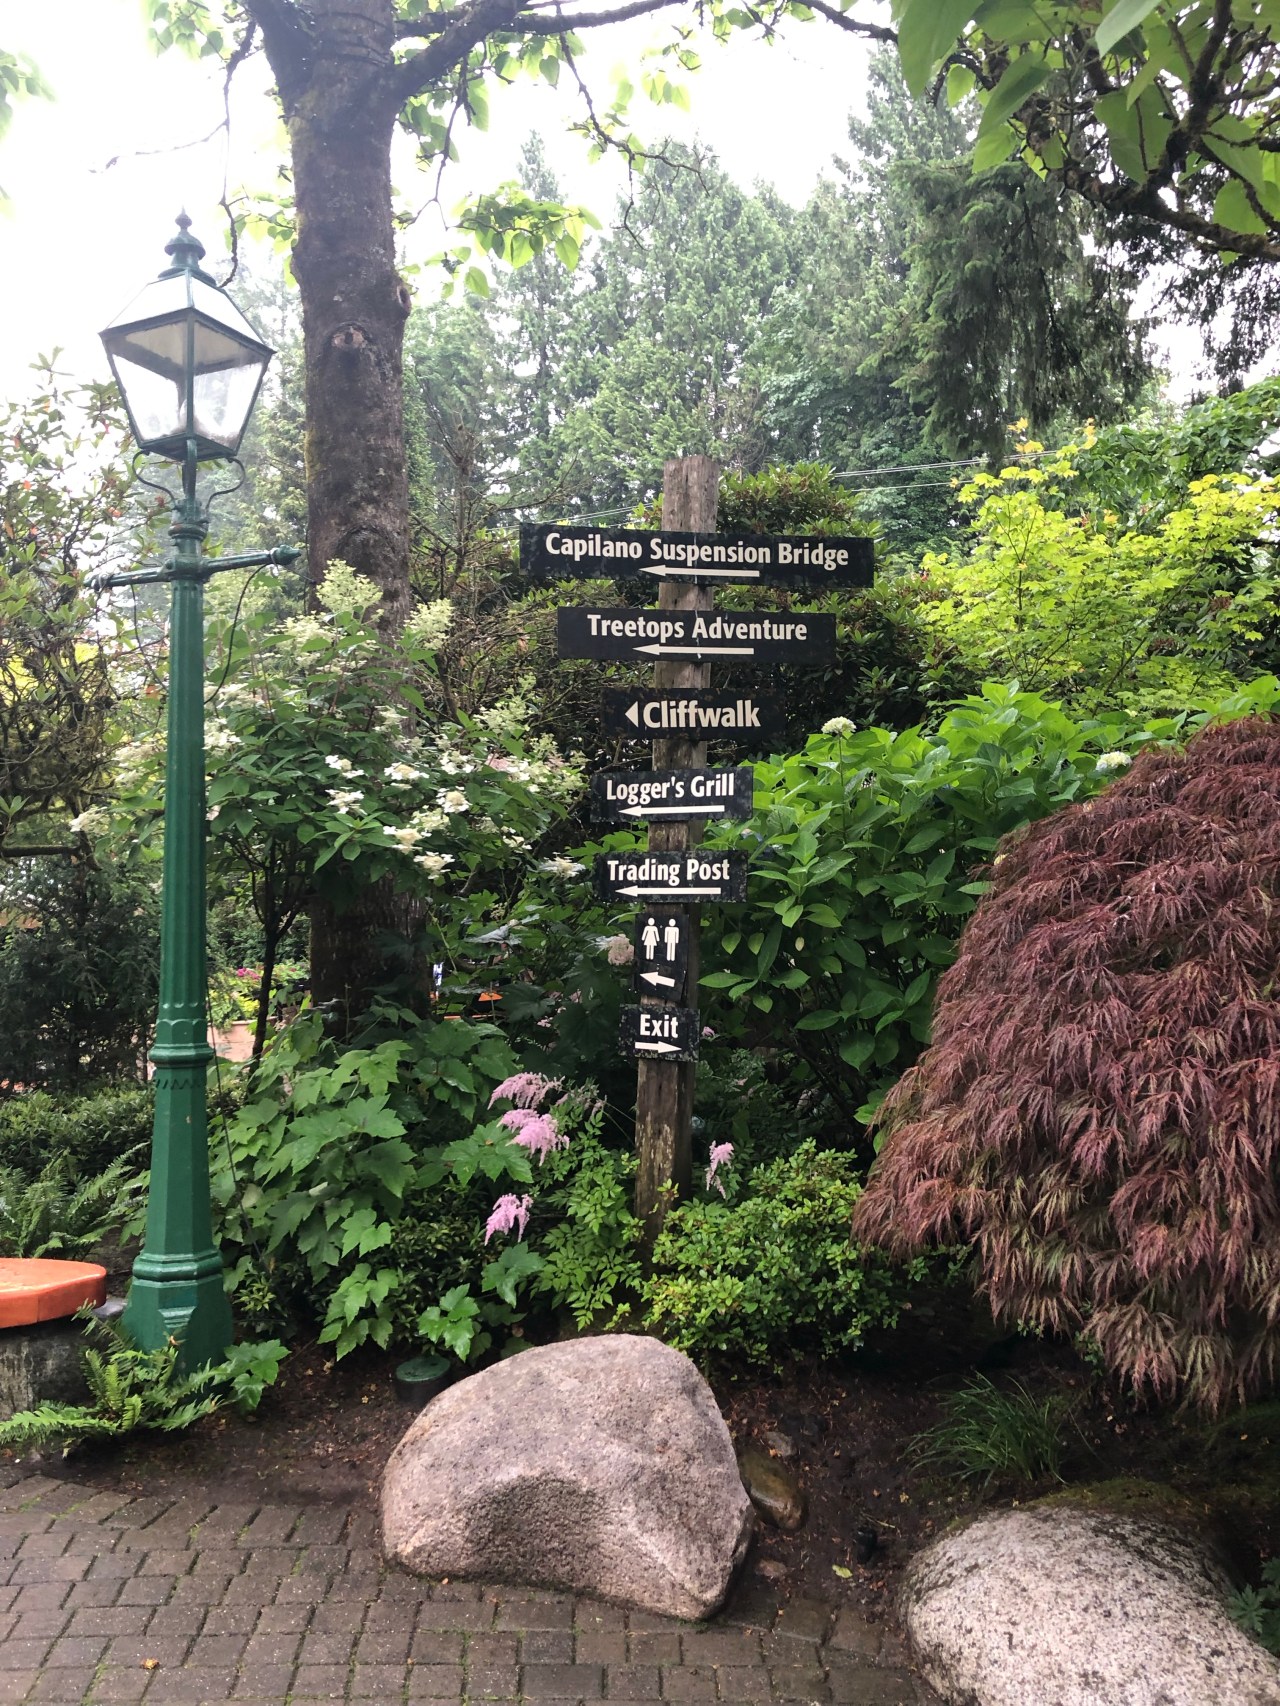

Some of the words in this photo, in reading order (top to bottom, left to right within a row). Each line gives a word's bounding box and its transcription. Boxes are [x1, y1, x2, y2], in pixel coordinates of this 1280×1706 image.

[545, 532, 643, 562] Capilano
[650, 537, 771, 567] Suspension
[778, 542, 849, 571] Bridge
[586, 614, 685, 644] Treetops
[691, 616, 808, 641] Adventure
[643, 699, 761, 729] Cliffwalk
[606, 775, 685, 806] Logger's
[690, 772, 735, 798] Grill
[606, 858, 681, 887] Trading
[686, 858, 730, 881] Post
[639, 1013, 679, 1039] Exit
